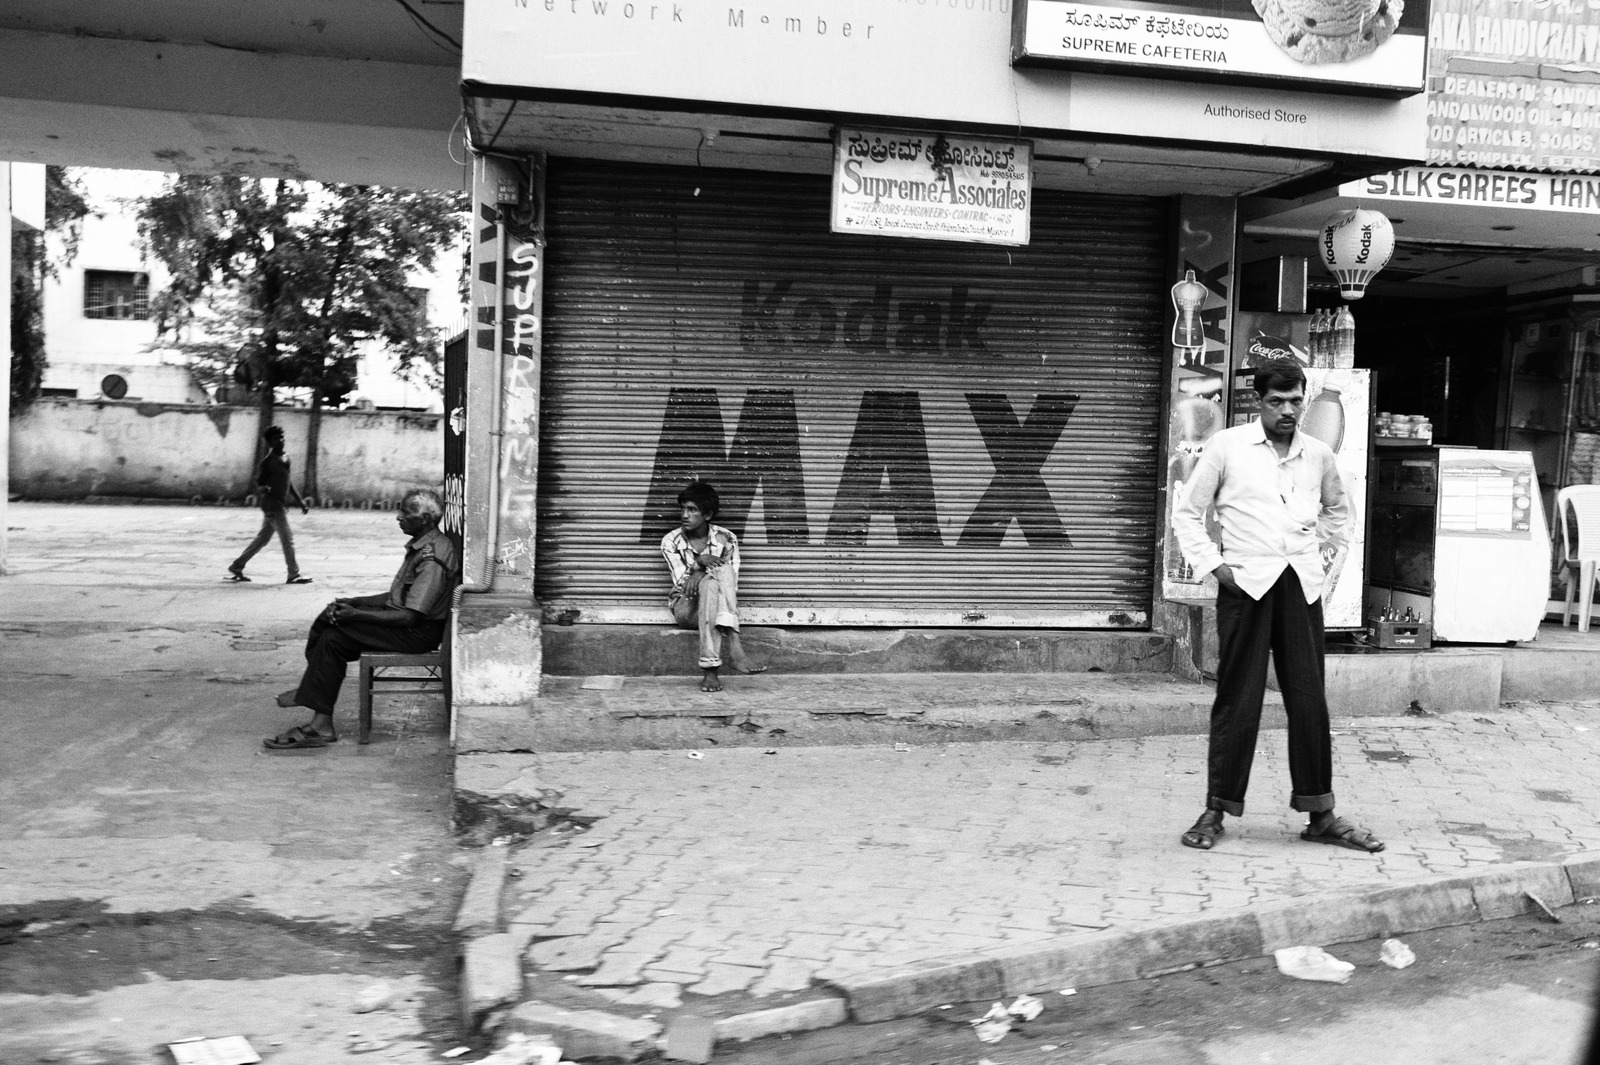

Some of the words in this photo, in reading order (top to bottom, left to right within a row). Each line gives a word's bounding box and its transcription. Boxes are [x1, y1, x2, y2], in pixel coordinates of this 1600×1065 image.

[1062, 36, 1137, 55] SUPREME
[1142, 44, 1227, 63] CAFETERIA
[1474, 15, 1600, 62] HANDICRAFT
[1445, 77, 1518, 100] DEALERS
[1204, 104, 1270, 120] Authorised
[1274, 109, 1307, 123] Store
[842, 159, 938, 204] Supreme
[935, 164, 1026, 211] Associates
[1367, 169, 1434, 198] SILK
[1437, 172, 1537, 204] SAREES
[903, 205, 948, 220] ENGINEERS
[1324, 225, 1336, 265] Kodak
[1355, 224, 1372, 264] Kodak
[740, 279, 992, 356] Kodak
[639, 387, 1080, 548] MAX
